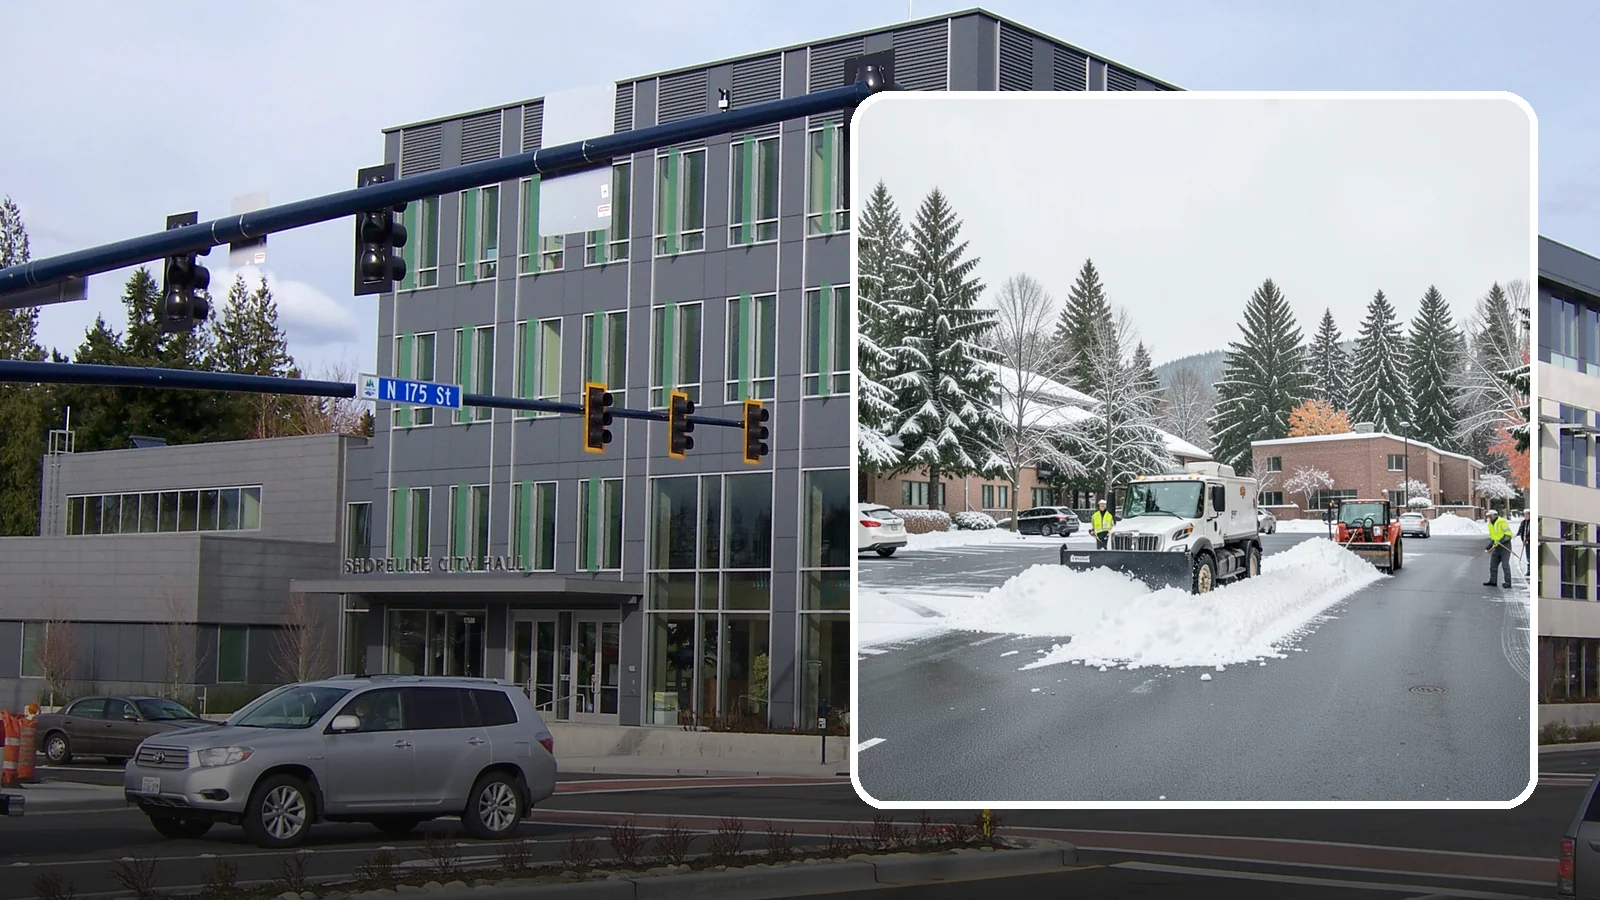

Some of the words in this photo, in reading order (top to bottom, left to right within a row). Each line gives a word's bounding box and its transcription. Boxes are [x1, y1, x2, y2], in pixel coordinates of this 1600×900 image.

[387, 380, 396, 400] N
[405, 382, 427, 403] 175
[436, 386, 451, 406] St
[344, 556, 432, 573] SHORELINE
[438, 556, 475, 572] CITY
[483, 555, 525, 571] HALL
